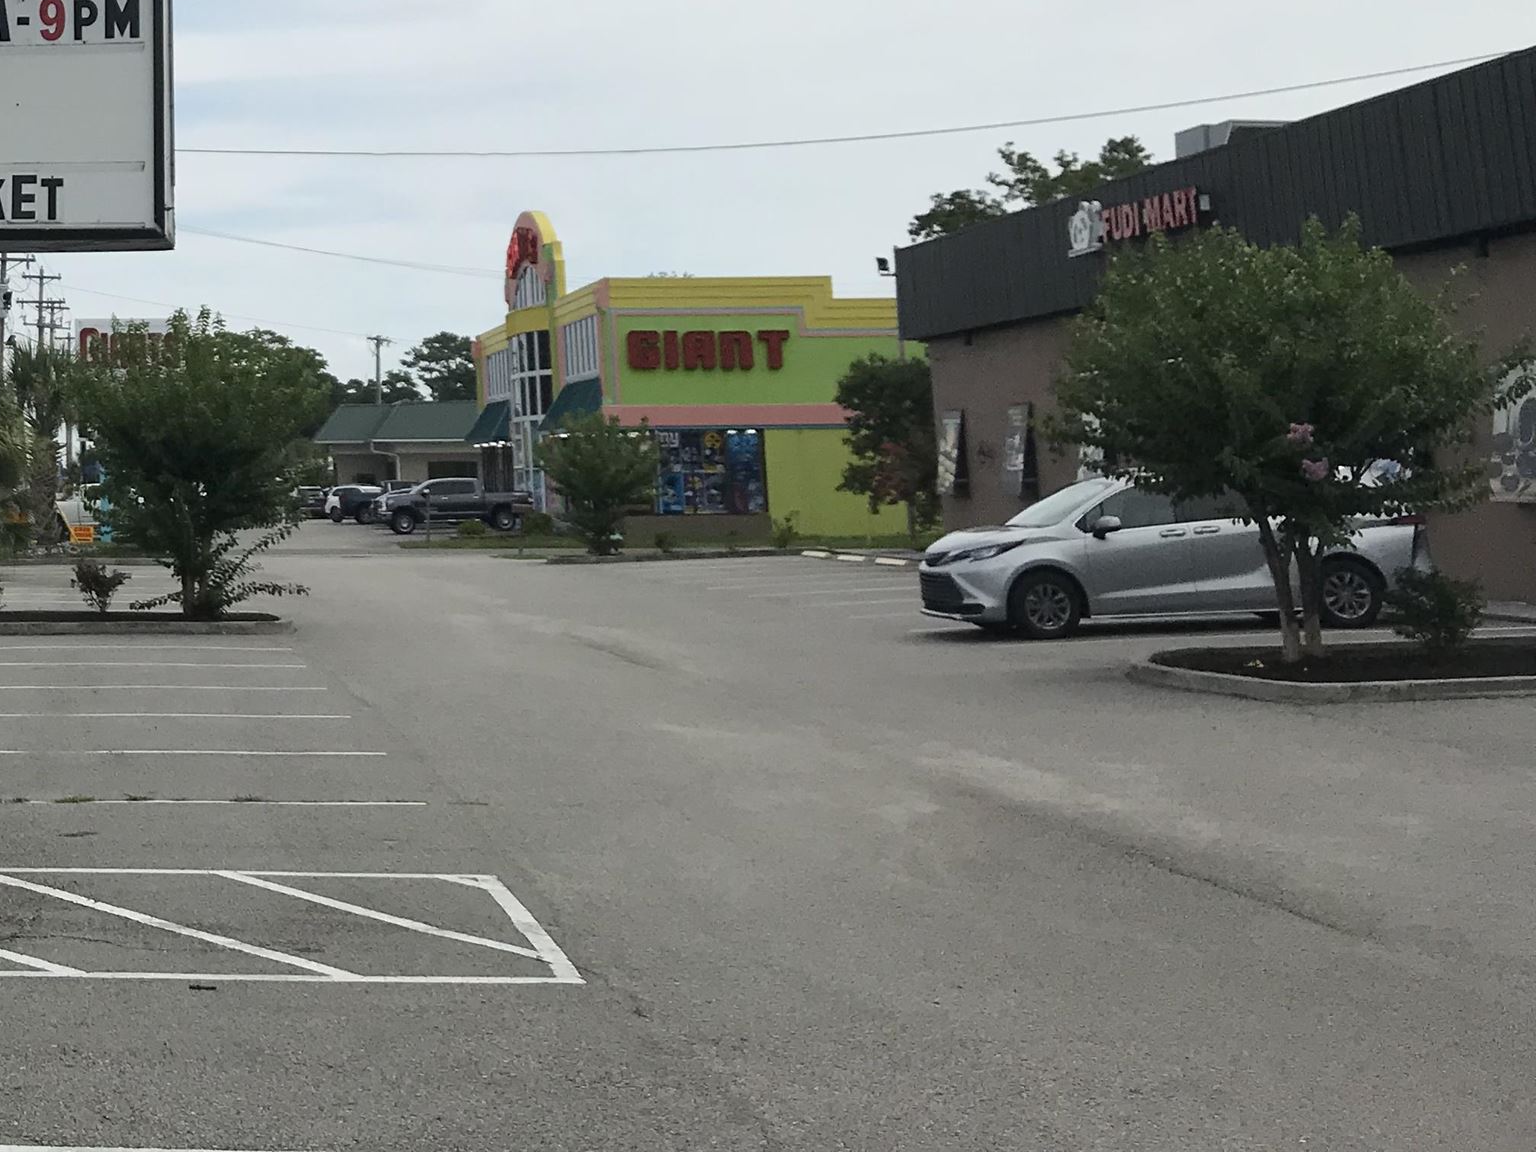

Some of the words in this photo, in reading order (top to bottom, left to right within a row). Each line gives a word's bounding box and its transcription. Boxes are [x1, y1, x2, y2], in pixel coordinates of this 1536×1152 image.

[1100, 201, 1140, 243] FUDI
[1145, 185, 1197, 233] MART
[627, 329, 790, 371] GIANT
